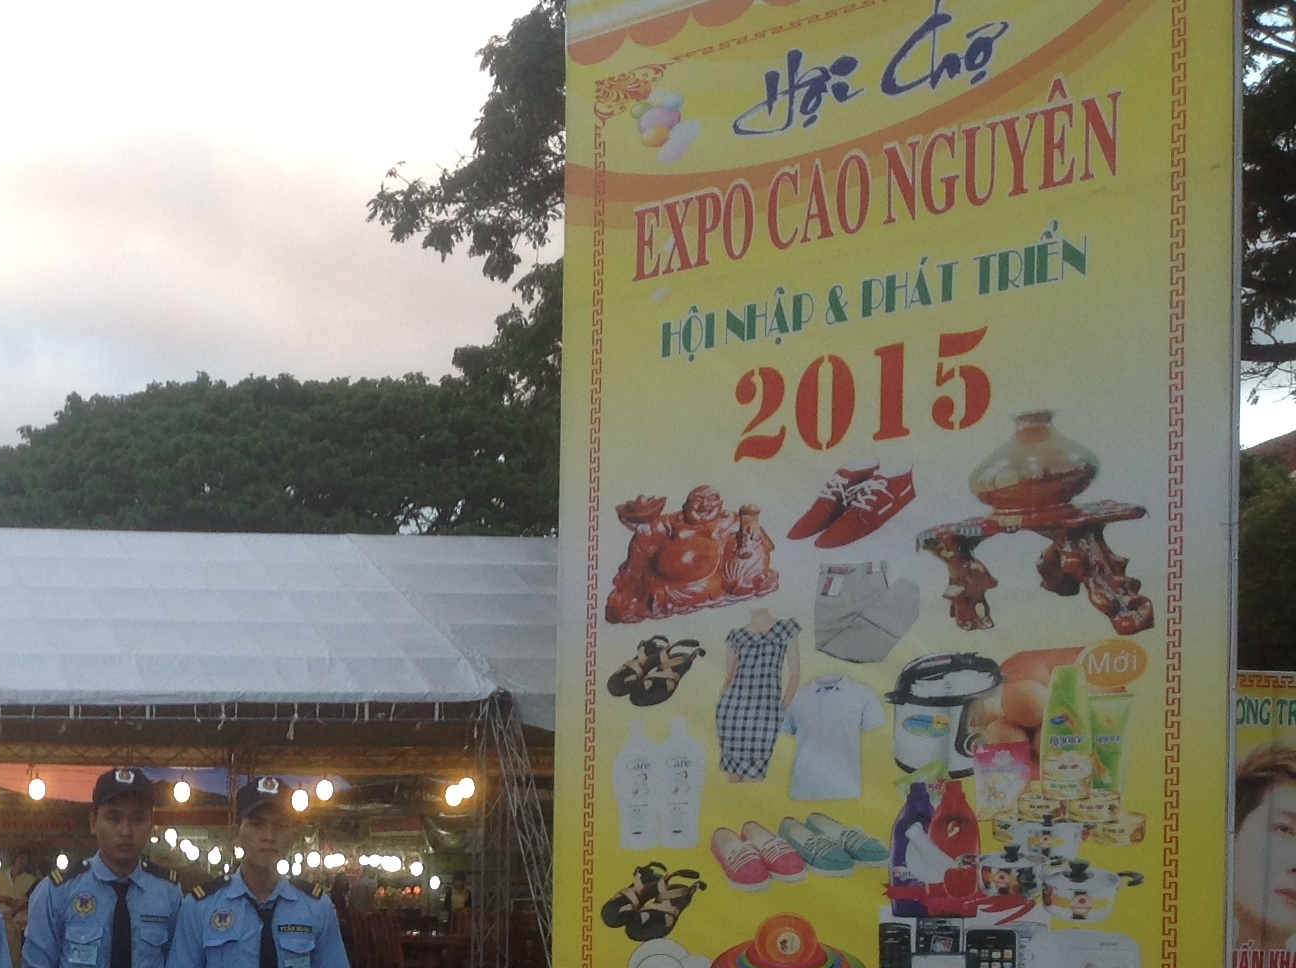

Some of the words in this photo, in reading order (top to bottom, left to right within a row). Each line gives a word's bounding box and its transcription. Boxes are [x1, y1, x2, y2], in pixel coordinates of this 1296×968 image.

[733, 49, 864, 134] Hội
[632, 182, 754, 282] EXPO
[767, 153, 870, 250] CAO
[883, 78, 1121, 225] NGUYÊN
[661, 305, 715, 362] HỘI
[725, 286, 814, 345] NHẬP
[825, 285, 848, 325] &
[862, 256, 959, 318] PHÁT
[973, 219, 1087, 296] TRIỂN
[734, 326, 991, 464] 2015
[1088, 650, 1138, 674] Mới
